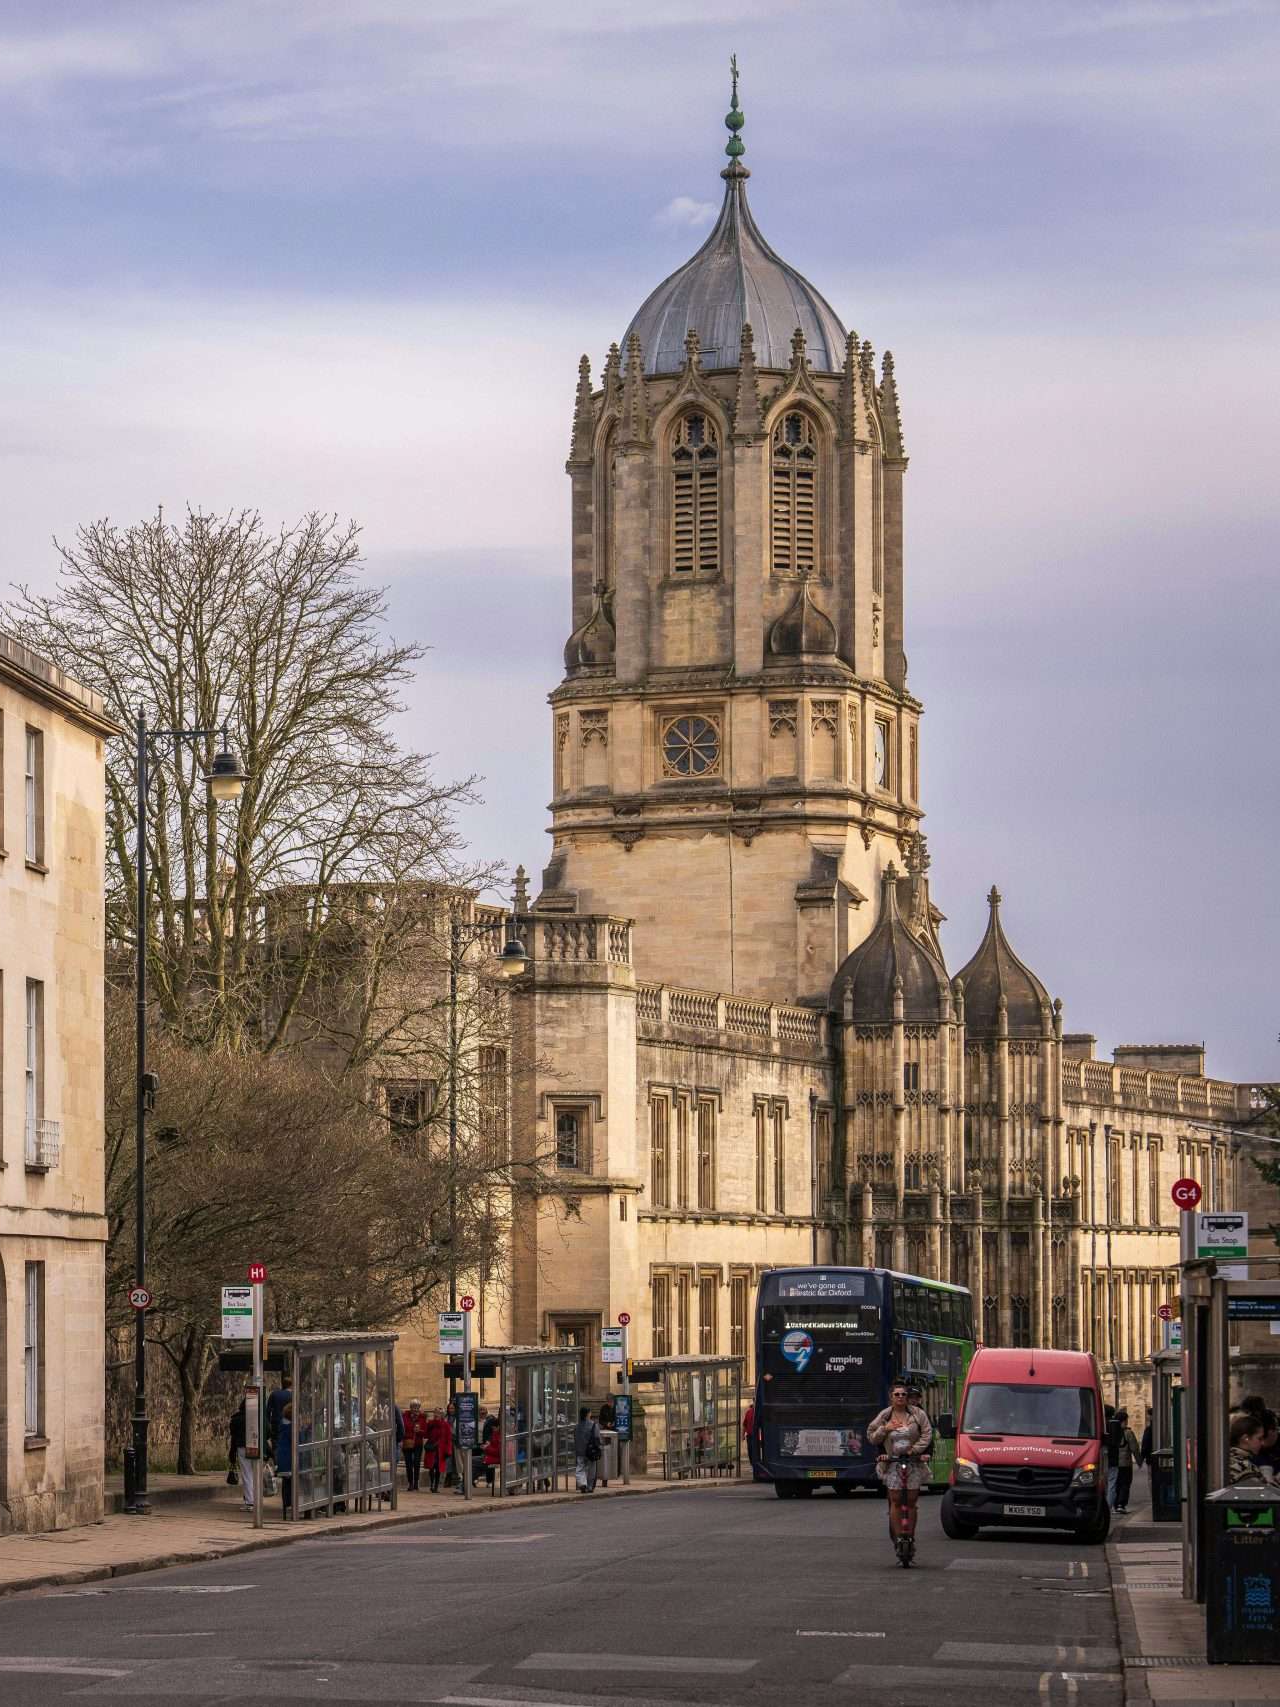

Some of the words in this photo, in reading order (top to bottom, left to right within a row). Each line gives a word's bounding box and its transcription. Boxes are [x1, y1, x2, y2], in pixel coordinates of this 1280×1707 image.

[1176, 1187, 1197, 1200] G4
[251, 1267, 264, 1279] H1
[133, 1293, 148, 1303] 20
[462, 1300, 473, 1308] H2
[829, 1355, 863, 1365] amping
[825, 1363, 832, 1371] it
[833, 1364, 845, 1372] up
[978, 1446, 1074, 1456] www.parcelforce.com
